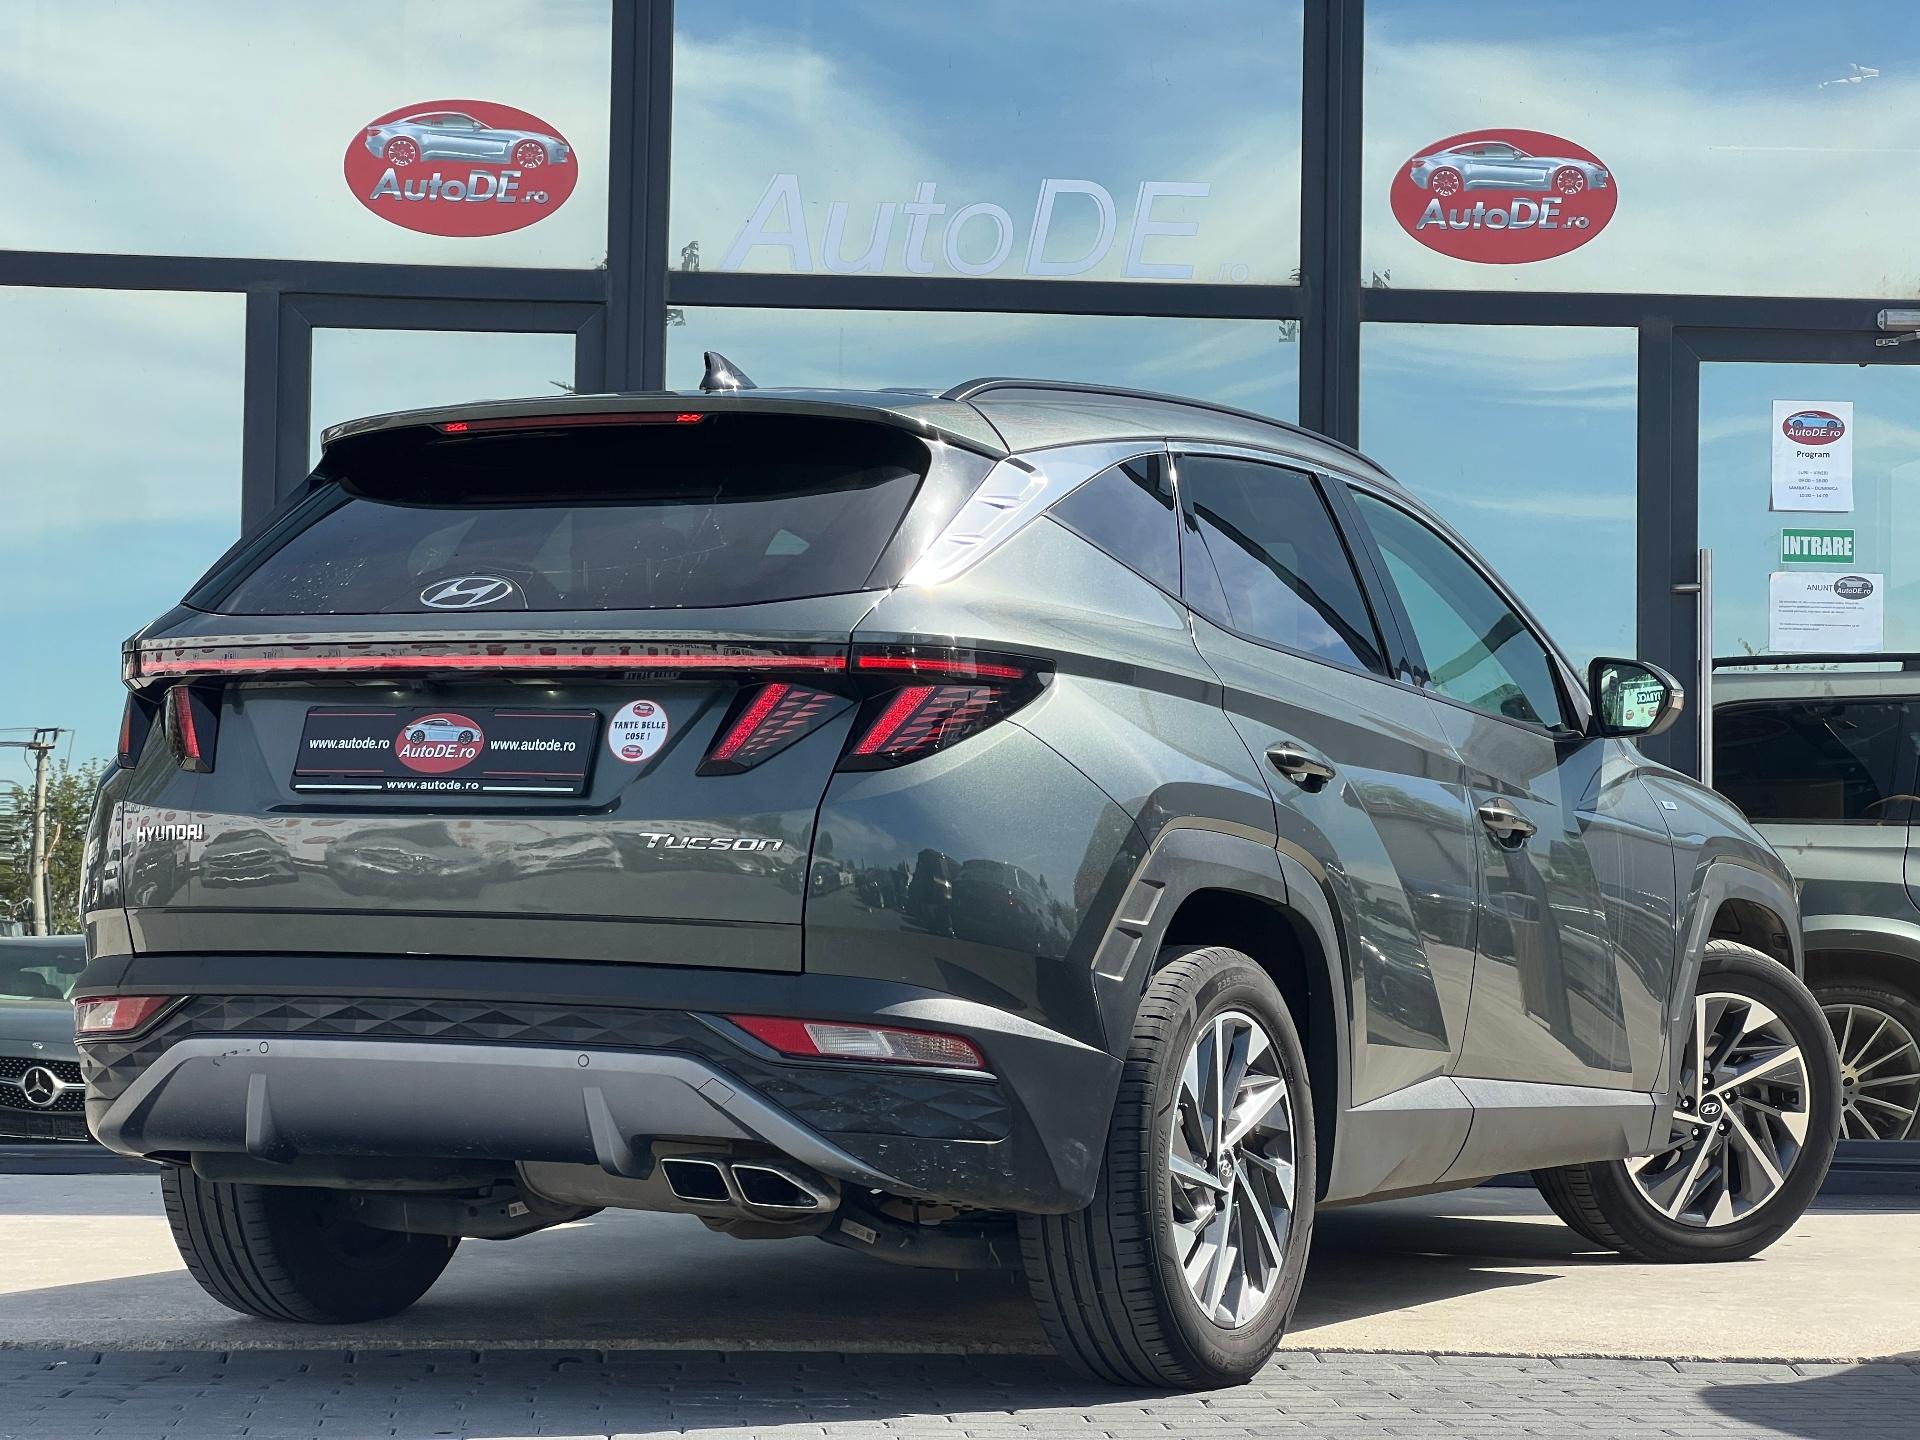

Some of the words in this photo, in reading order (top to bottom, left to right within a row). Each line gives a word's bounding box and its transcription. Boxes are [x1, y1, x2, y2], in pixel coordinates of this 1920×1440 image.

[1787, 427, 1841, 437] AutoDE.ro
[1796, 450, 1830, 459] Program
[1783, 535, 1853, 556] INTRARE
[614, 721, 638, 729] TANTE
[642, 721, 667, 729] BELLE
[625, 732, 645, 740] COSE
[309, 737, 390, 749] www.autode.ro
[490, 739, 576, 751] www.autode.ro
[398, 743, 476, 759] AutoDE.ro
[386, 780, 480, 790] www.autode.ro
[136, 824, 204, 842] HYUNDAI
